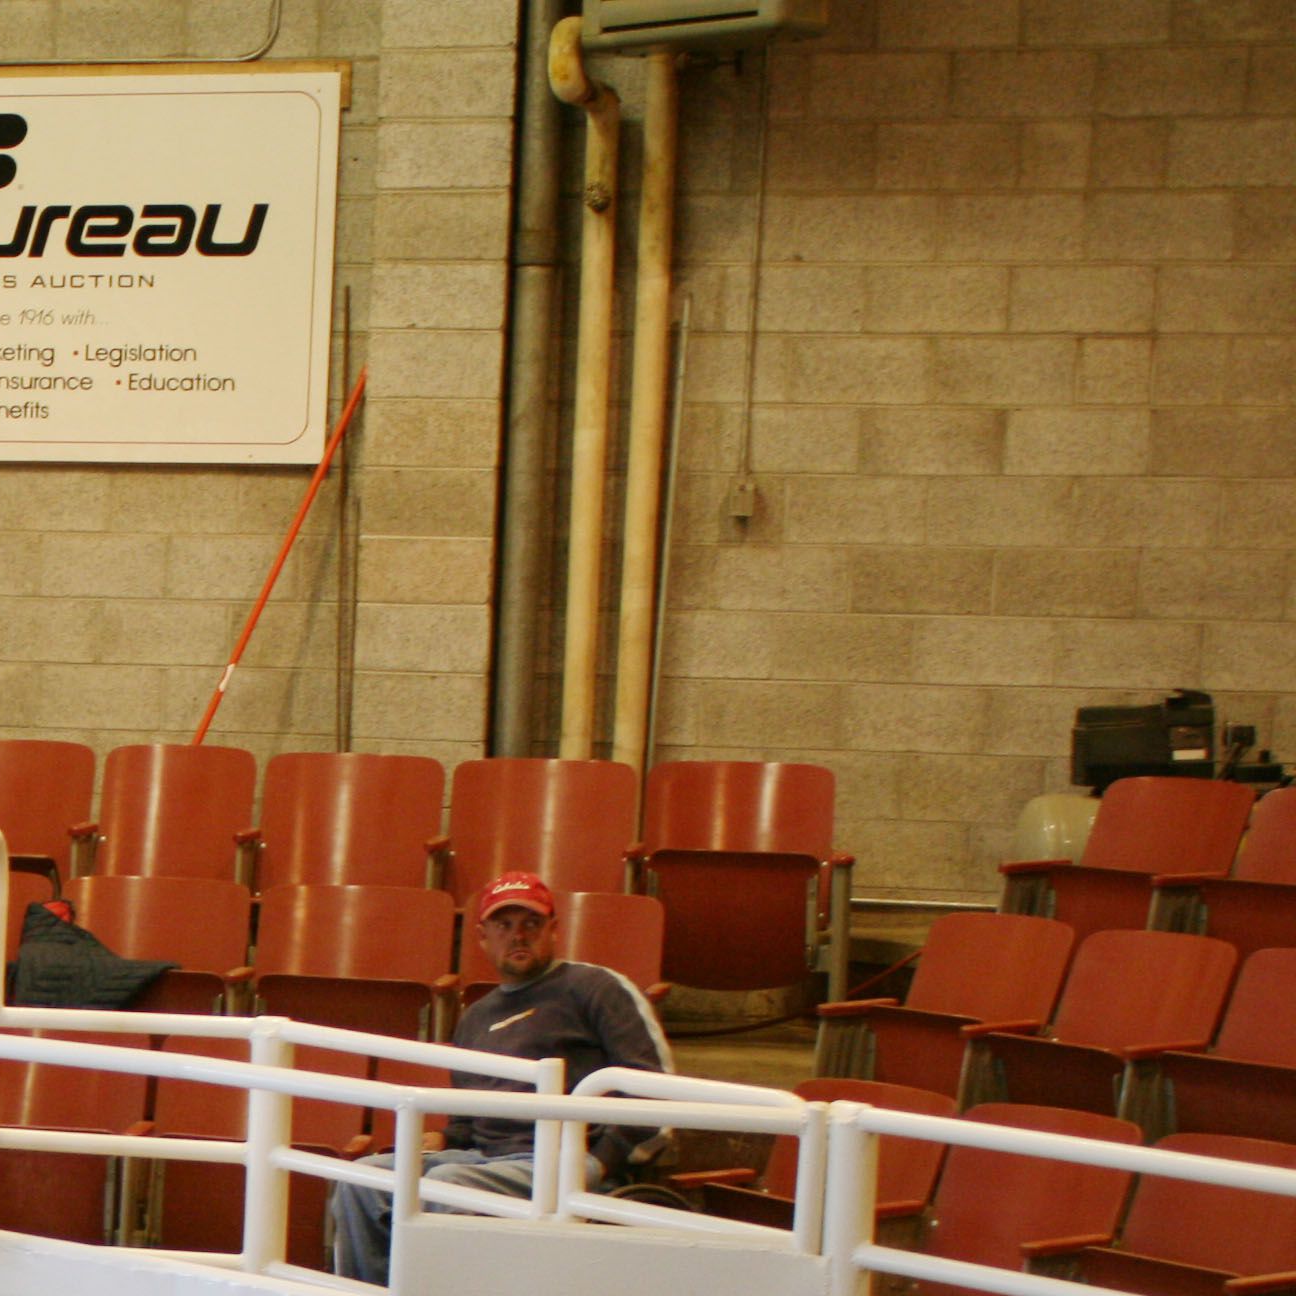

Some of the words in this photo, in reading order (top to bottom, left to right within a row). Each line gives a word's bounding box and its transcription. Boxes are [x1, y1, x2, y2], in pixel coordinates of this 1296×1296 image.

[30, 274, 156, 289] AUCTION
[18, 308, 55, 327] 1916
[84, 344, 197, 368] Legislation
[128, 373, 236, 391] Education
